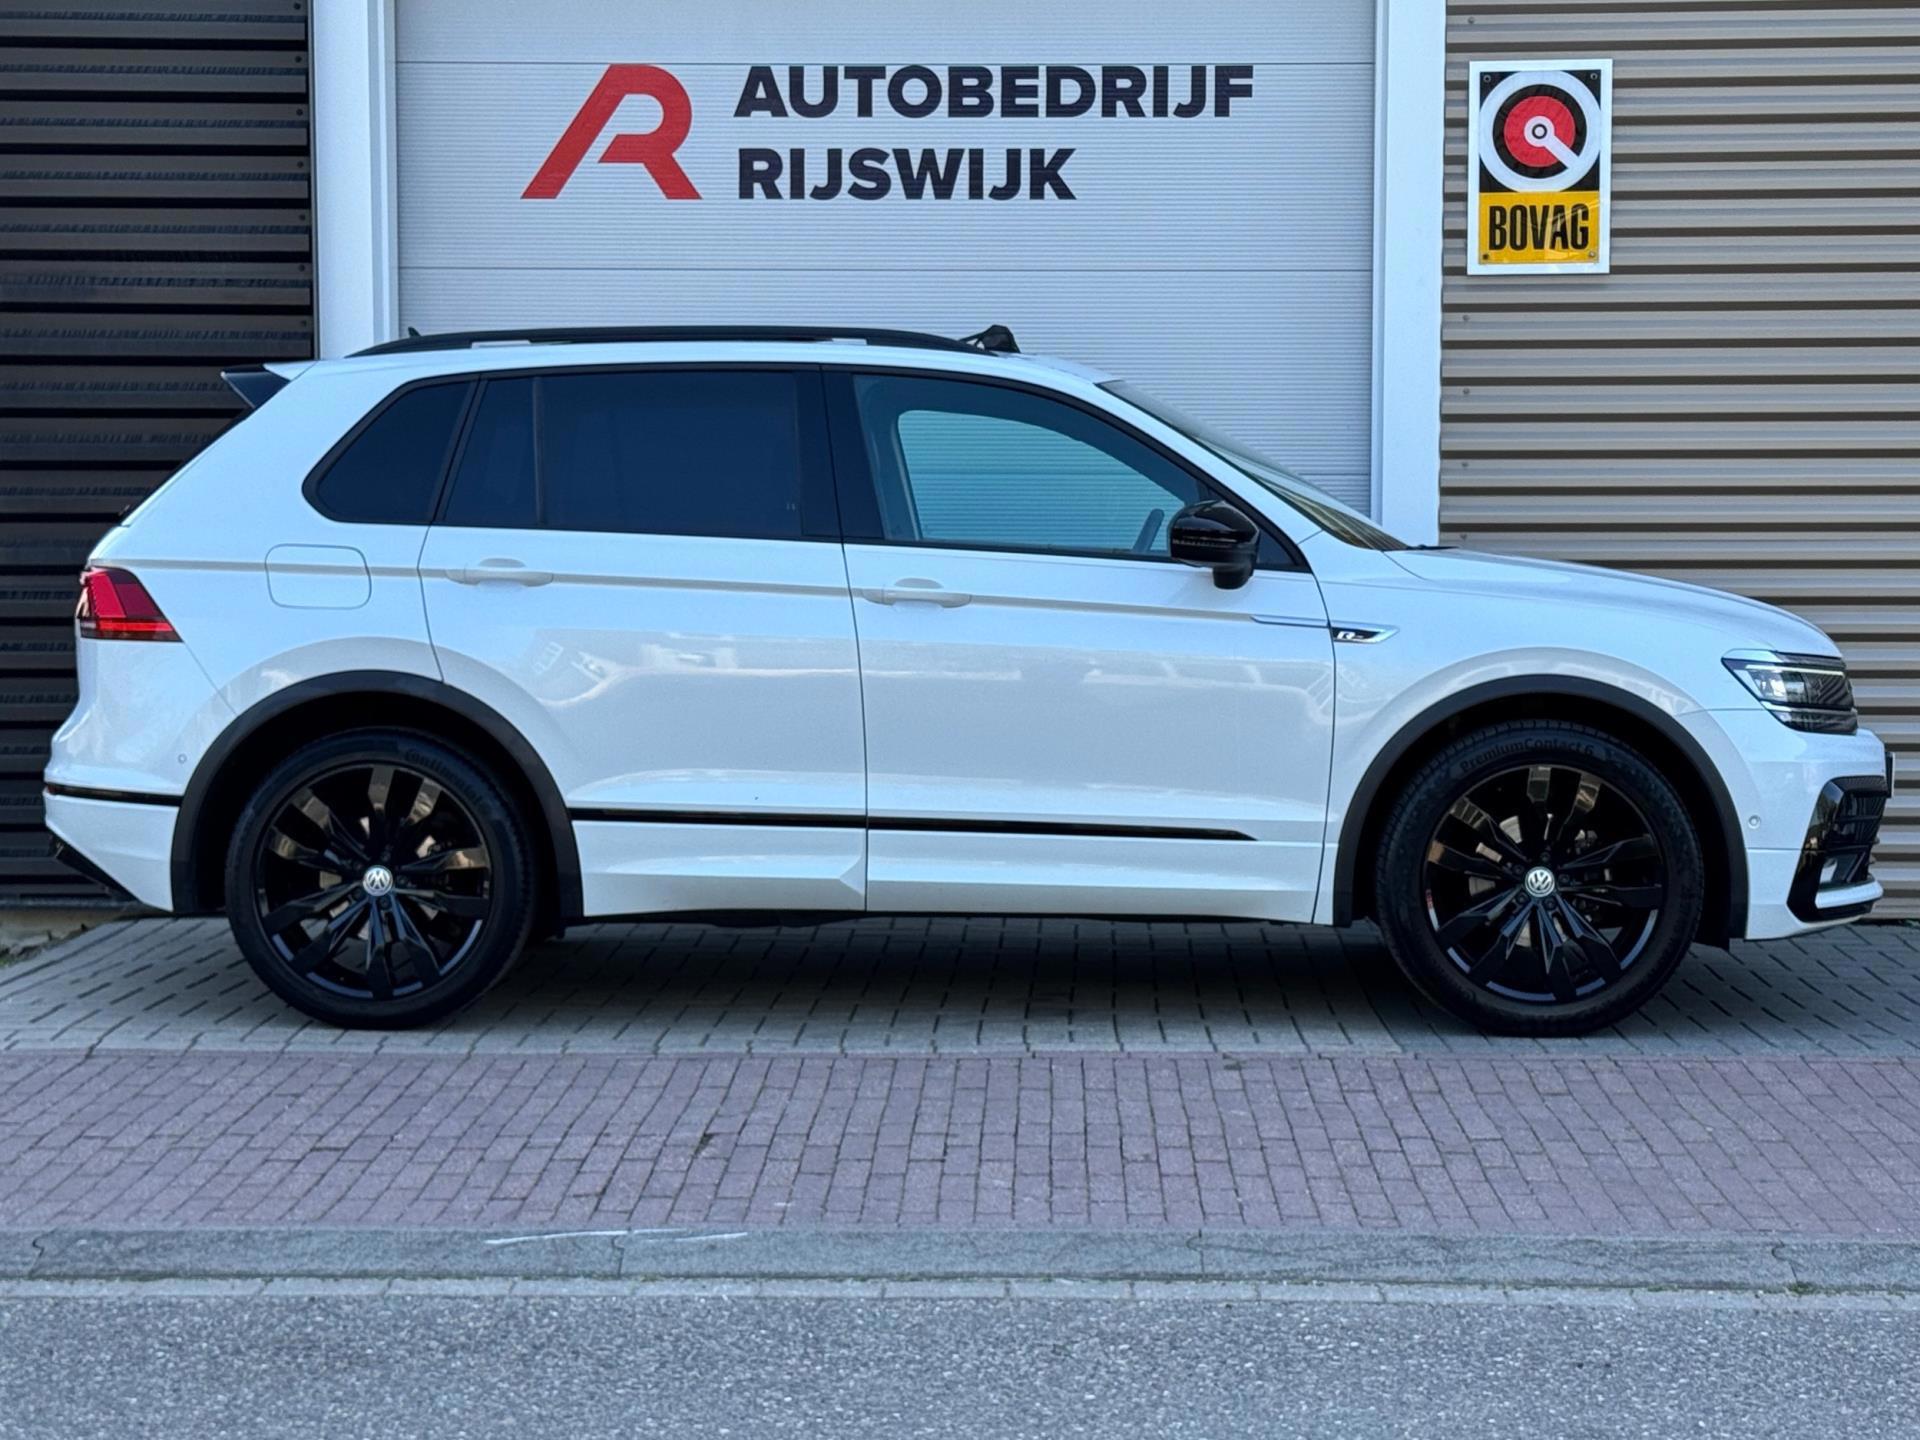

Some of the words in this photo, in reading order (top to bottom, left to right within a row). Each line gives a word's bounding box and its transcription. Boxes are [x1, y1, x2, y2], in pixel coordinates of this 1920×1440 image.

[734, 65, 1254, 119] AUTOBEDRIJF
[738, 148, 1076, 200] RIJSWIJK
[1488, 204, 1590, 251] BOVAG
[1461, 737, 1582, 772] PremiumContact
[1584, 744, 1594, 756] 6
